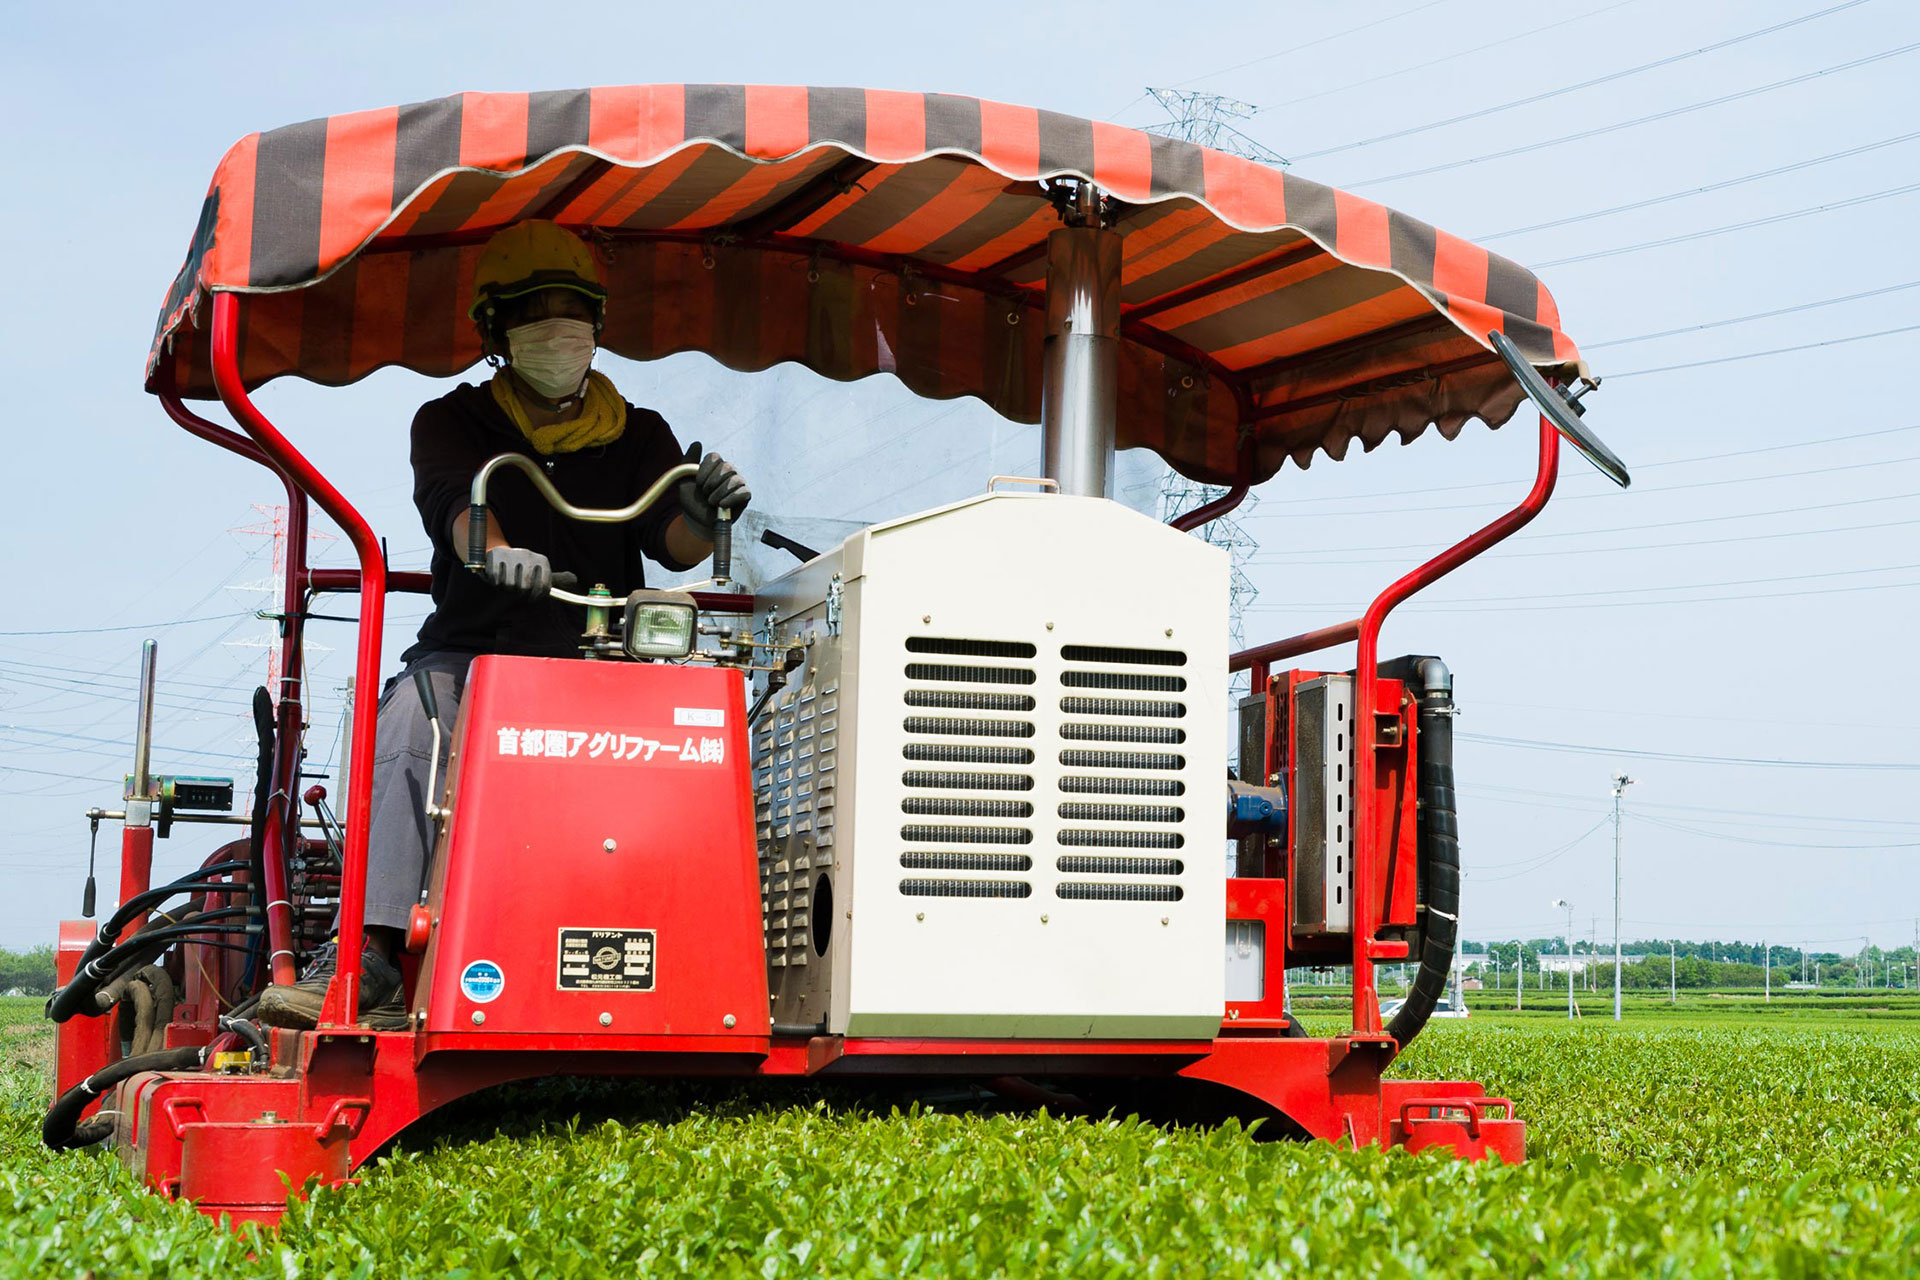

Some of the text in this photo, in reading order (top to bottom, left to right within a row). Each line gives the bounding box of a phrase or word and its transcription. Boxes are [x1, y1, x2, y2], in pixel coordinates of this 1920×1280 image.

[591, 931, 624, 939] バリアント
